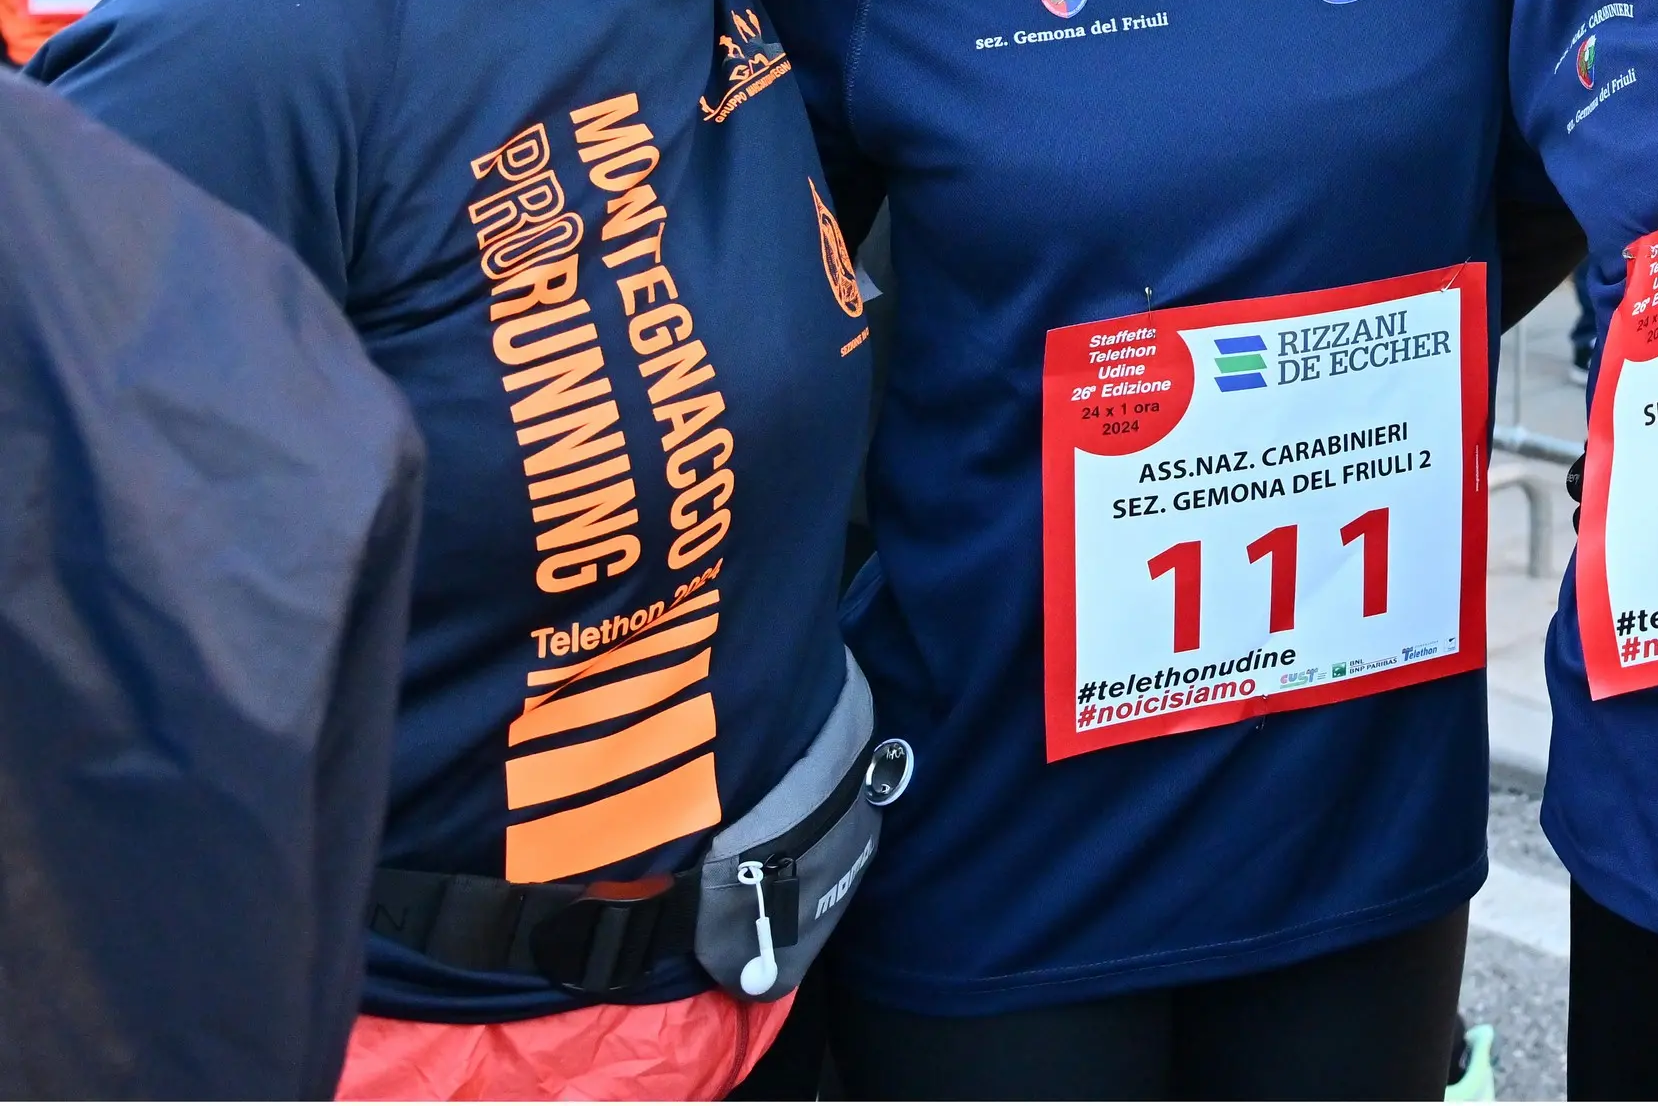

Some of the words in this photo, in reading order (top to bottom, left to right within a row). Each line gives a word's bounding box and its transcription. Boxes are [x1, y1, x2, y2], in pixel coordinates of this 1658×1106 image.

[975, 36, 1008, 50] sez.
[1013, 25, 1086, 45] Gemona
[1091, 19, 1117, 35] del
[1122, 12, 1169, 32] Friuli
[1599, 82, 1610, 102] del
[1611, 68, 1637, 94] Friuli
[715, 92, 748, 123] GRUPPO
[569, 92, 735, 571] MONTEGNACCO
[1278, 310, 1408, 358] RIZZANI
[1637, 316, 1649, 332] 24
[1652, 313, 1657, 323] x
[1089, 345, 1156, 363] Telethon
[1098, 364, 1145, 379] Udine
[1278, 356, 1325, 385] DE
[1328, 331, 1451, 376] ECCHER
[1101, 380, 1171, 397] Edizione
[1082, 406, 1100, 419] 24
[1106, 407, 1114, 416] x
[1121, 403, 1127, 414] 1
[1134, 402, 1160, 413] ora
[1102, 420, 1139, 435] 2024
[1262, 422, 1408, 468] CARABINIERI
[1112, 494, 1166, 519] SEZ.
[1173, 478, 1286, 511] GEMONA
[1292, 470, 1336, 494] DEL
[1342, 452, 1413, 484] FRIULI
[1418, 450, 1432, 470] 2
[1147, 507, 1389, 653] 111
[531, 601, 664, 659] Telethon
[669, 558, 724, 607] 2024
[1350, 666, 1365, 674] BNP
[1367, 658, 1398, 670] PARIBAS
[1402, 646, 1437, 661] Telethon
[1077, 648, 1296, 702] #telethonudine
[1077, 678, 1256, 727] #noicisiamo
